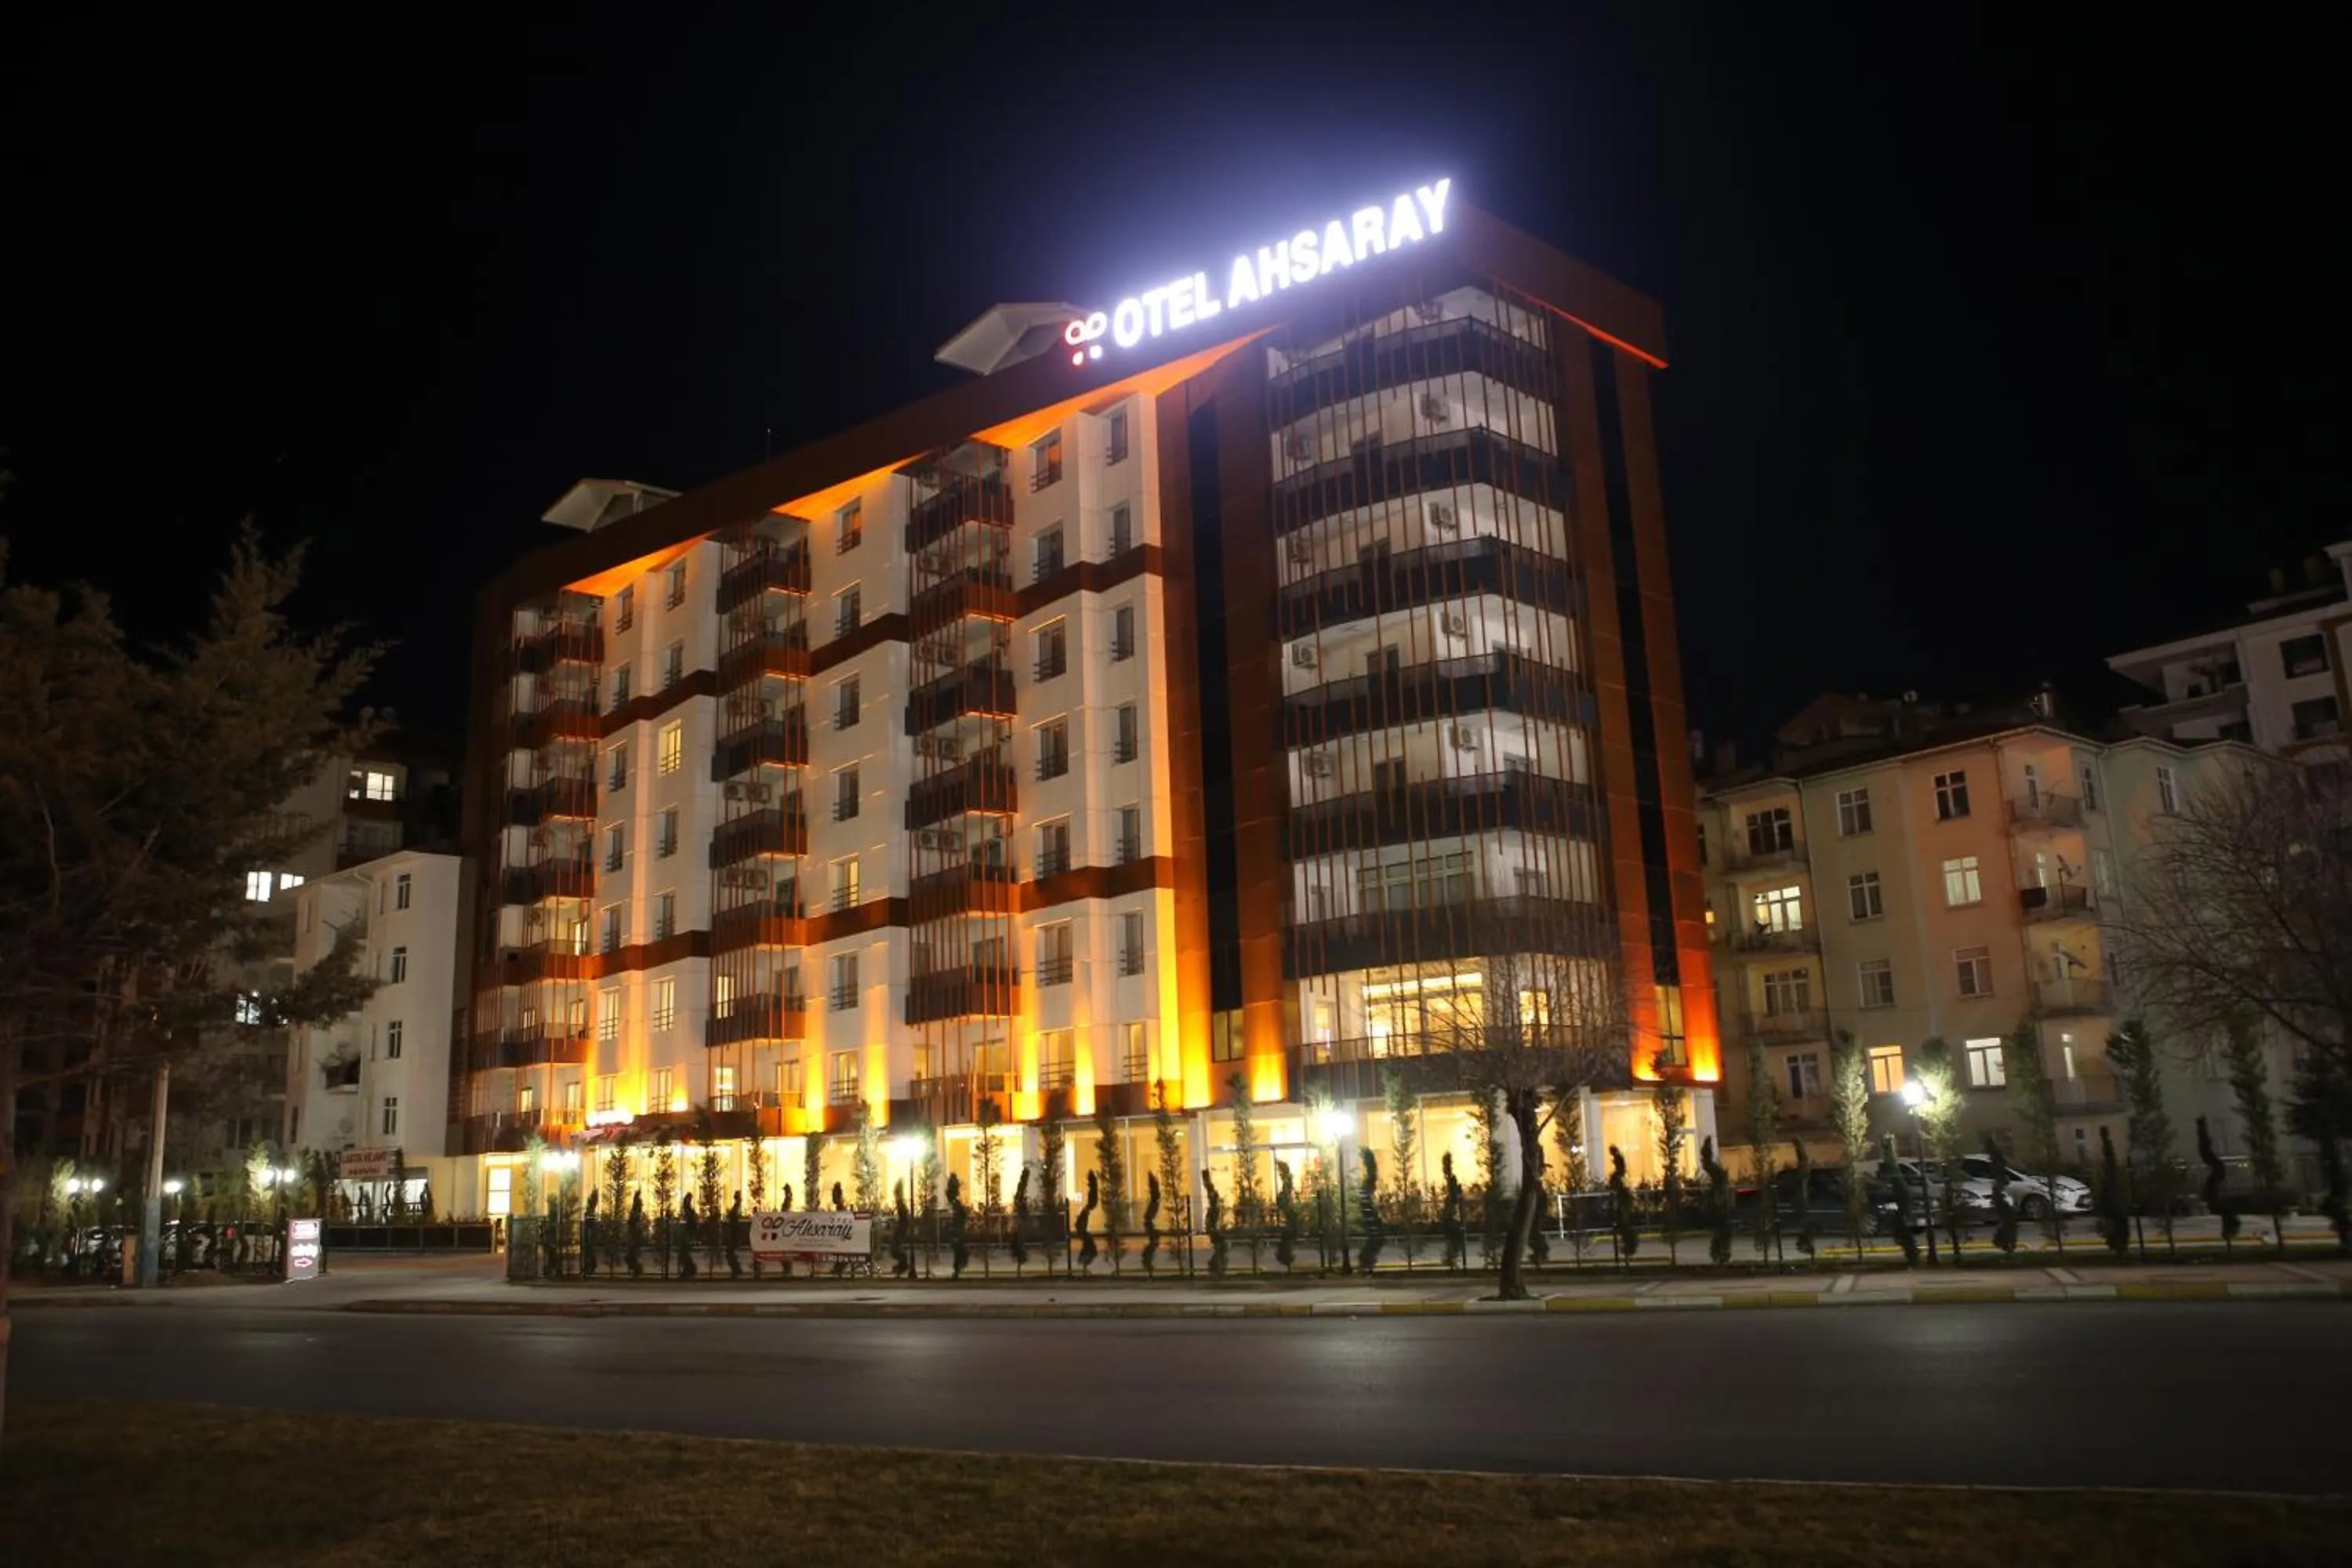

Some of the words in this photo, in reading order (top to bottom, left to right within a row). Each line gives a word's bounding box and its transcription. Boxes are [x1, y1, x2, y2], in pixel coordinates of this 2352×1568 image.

[1112, 271, 1221, 348] OTEL
[1228, 178, 1450, 309] AHSARAY
[782, 1218, 854, 1242] Ahsaray
